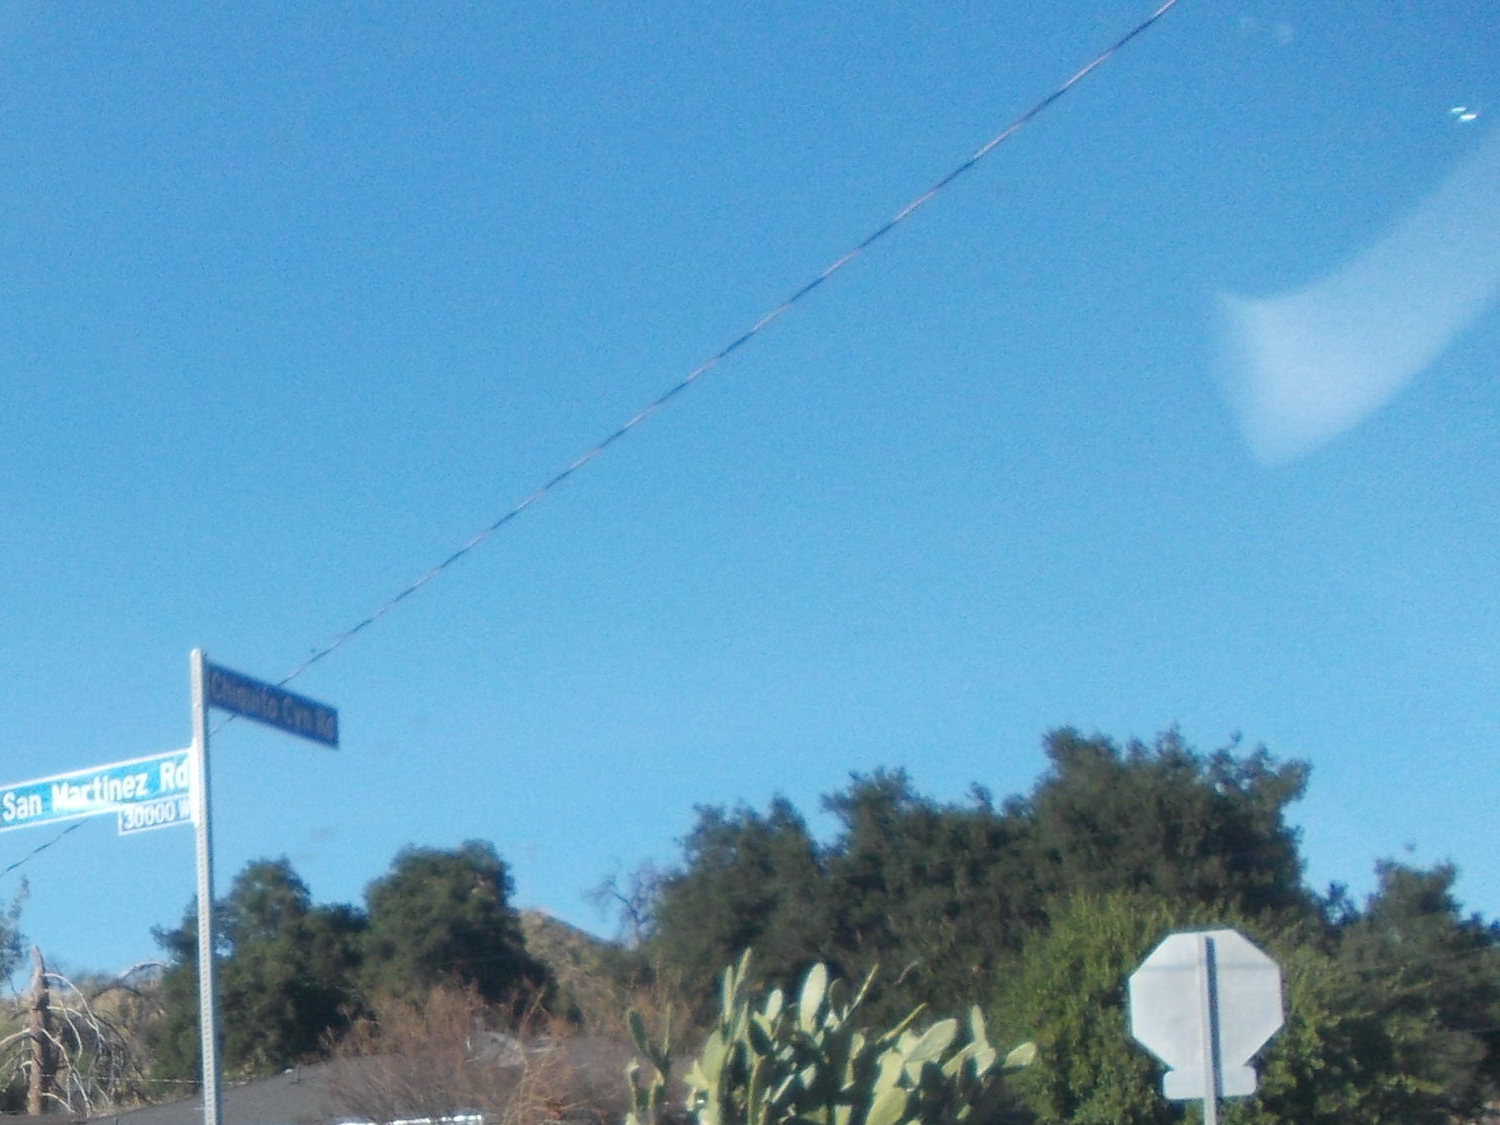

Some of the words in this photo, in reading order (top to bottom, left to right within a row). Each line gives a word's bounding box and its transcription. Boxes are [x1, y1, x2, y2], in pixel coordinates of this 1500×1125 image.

[3, 791, 43, 822] San
[51, 771, 149, 814] Martinez
[159, 757, 190, 791] Rd
